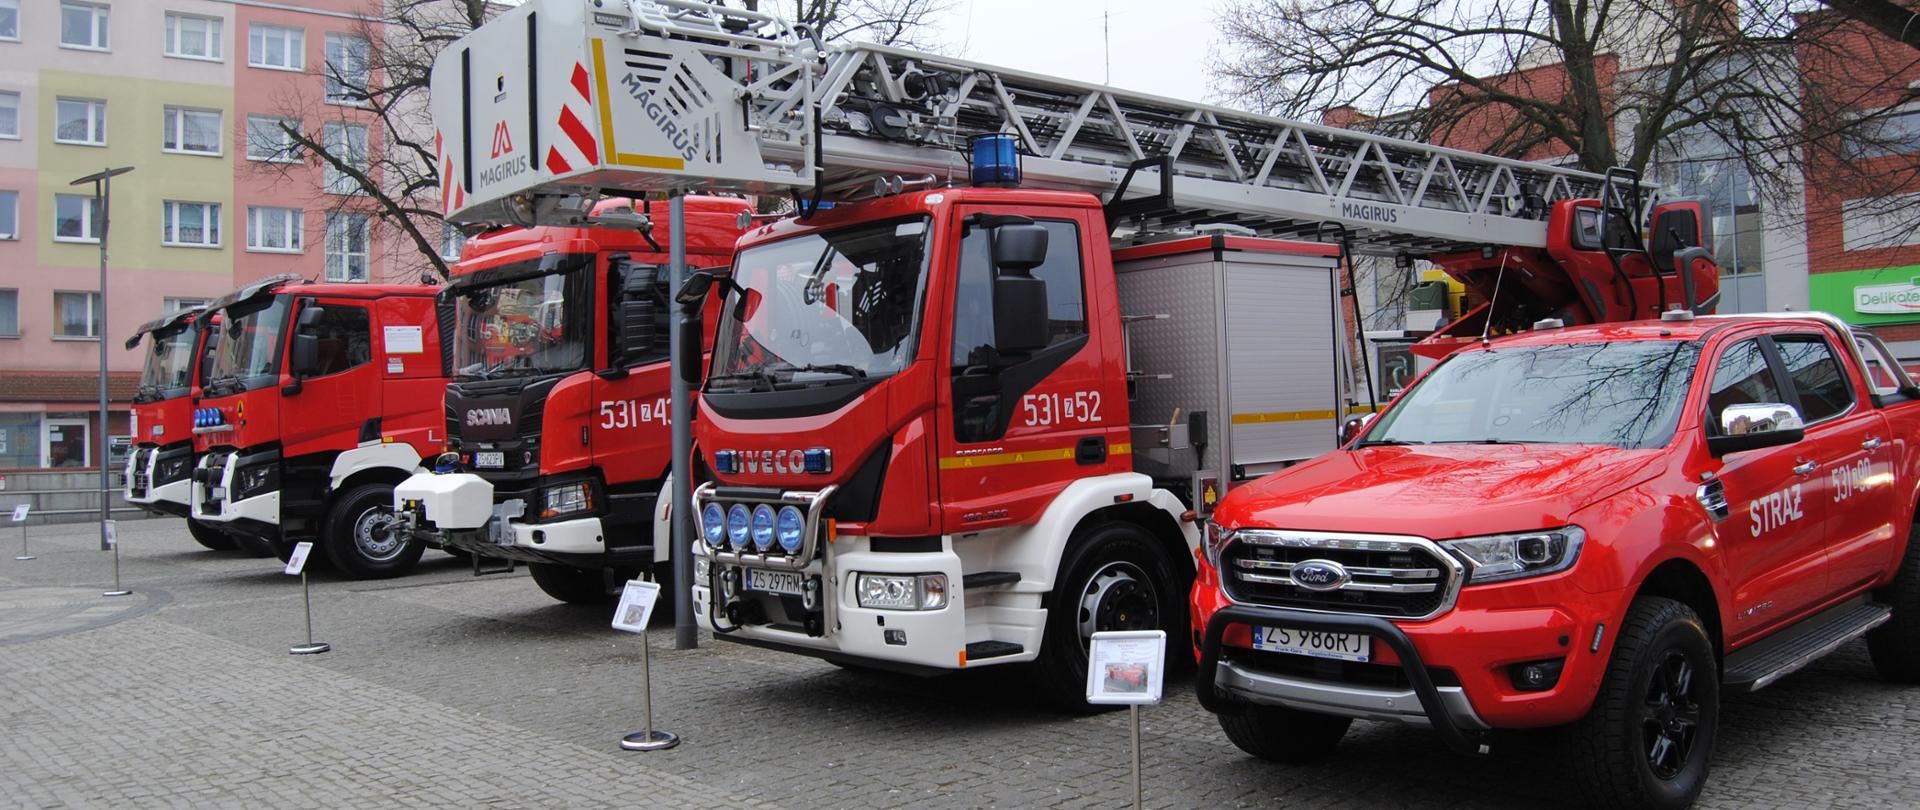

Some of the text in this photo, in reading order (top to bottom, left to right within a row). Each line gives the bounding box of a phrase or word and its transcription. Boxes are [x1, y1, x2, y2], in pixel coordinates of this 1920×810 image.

[620, 72, 698, 162] MAGIRUS
[480, 155, 526, 188] MAGIRUS
[1342, 202, 1397, 223] MAGIRUS
[466, 407, 512, 426] SCANIA
[601, 400, 637, 429] 531
[1023, 392, 1060, 426] 531
[1075, 391, 1102, 422] 52
[738, 449, 805, 474] IVECO
[1831, 463, 1852, 503] 531
[753, 571, 800, 593] ZS 297RM
[1300, 566, 1330, 583] Ford
[1266, 626, 1362, 653] ZS 986RJ
